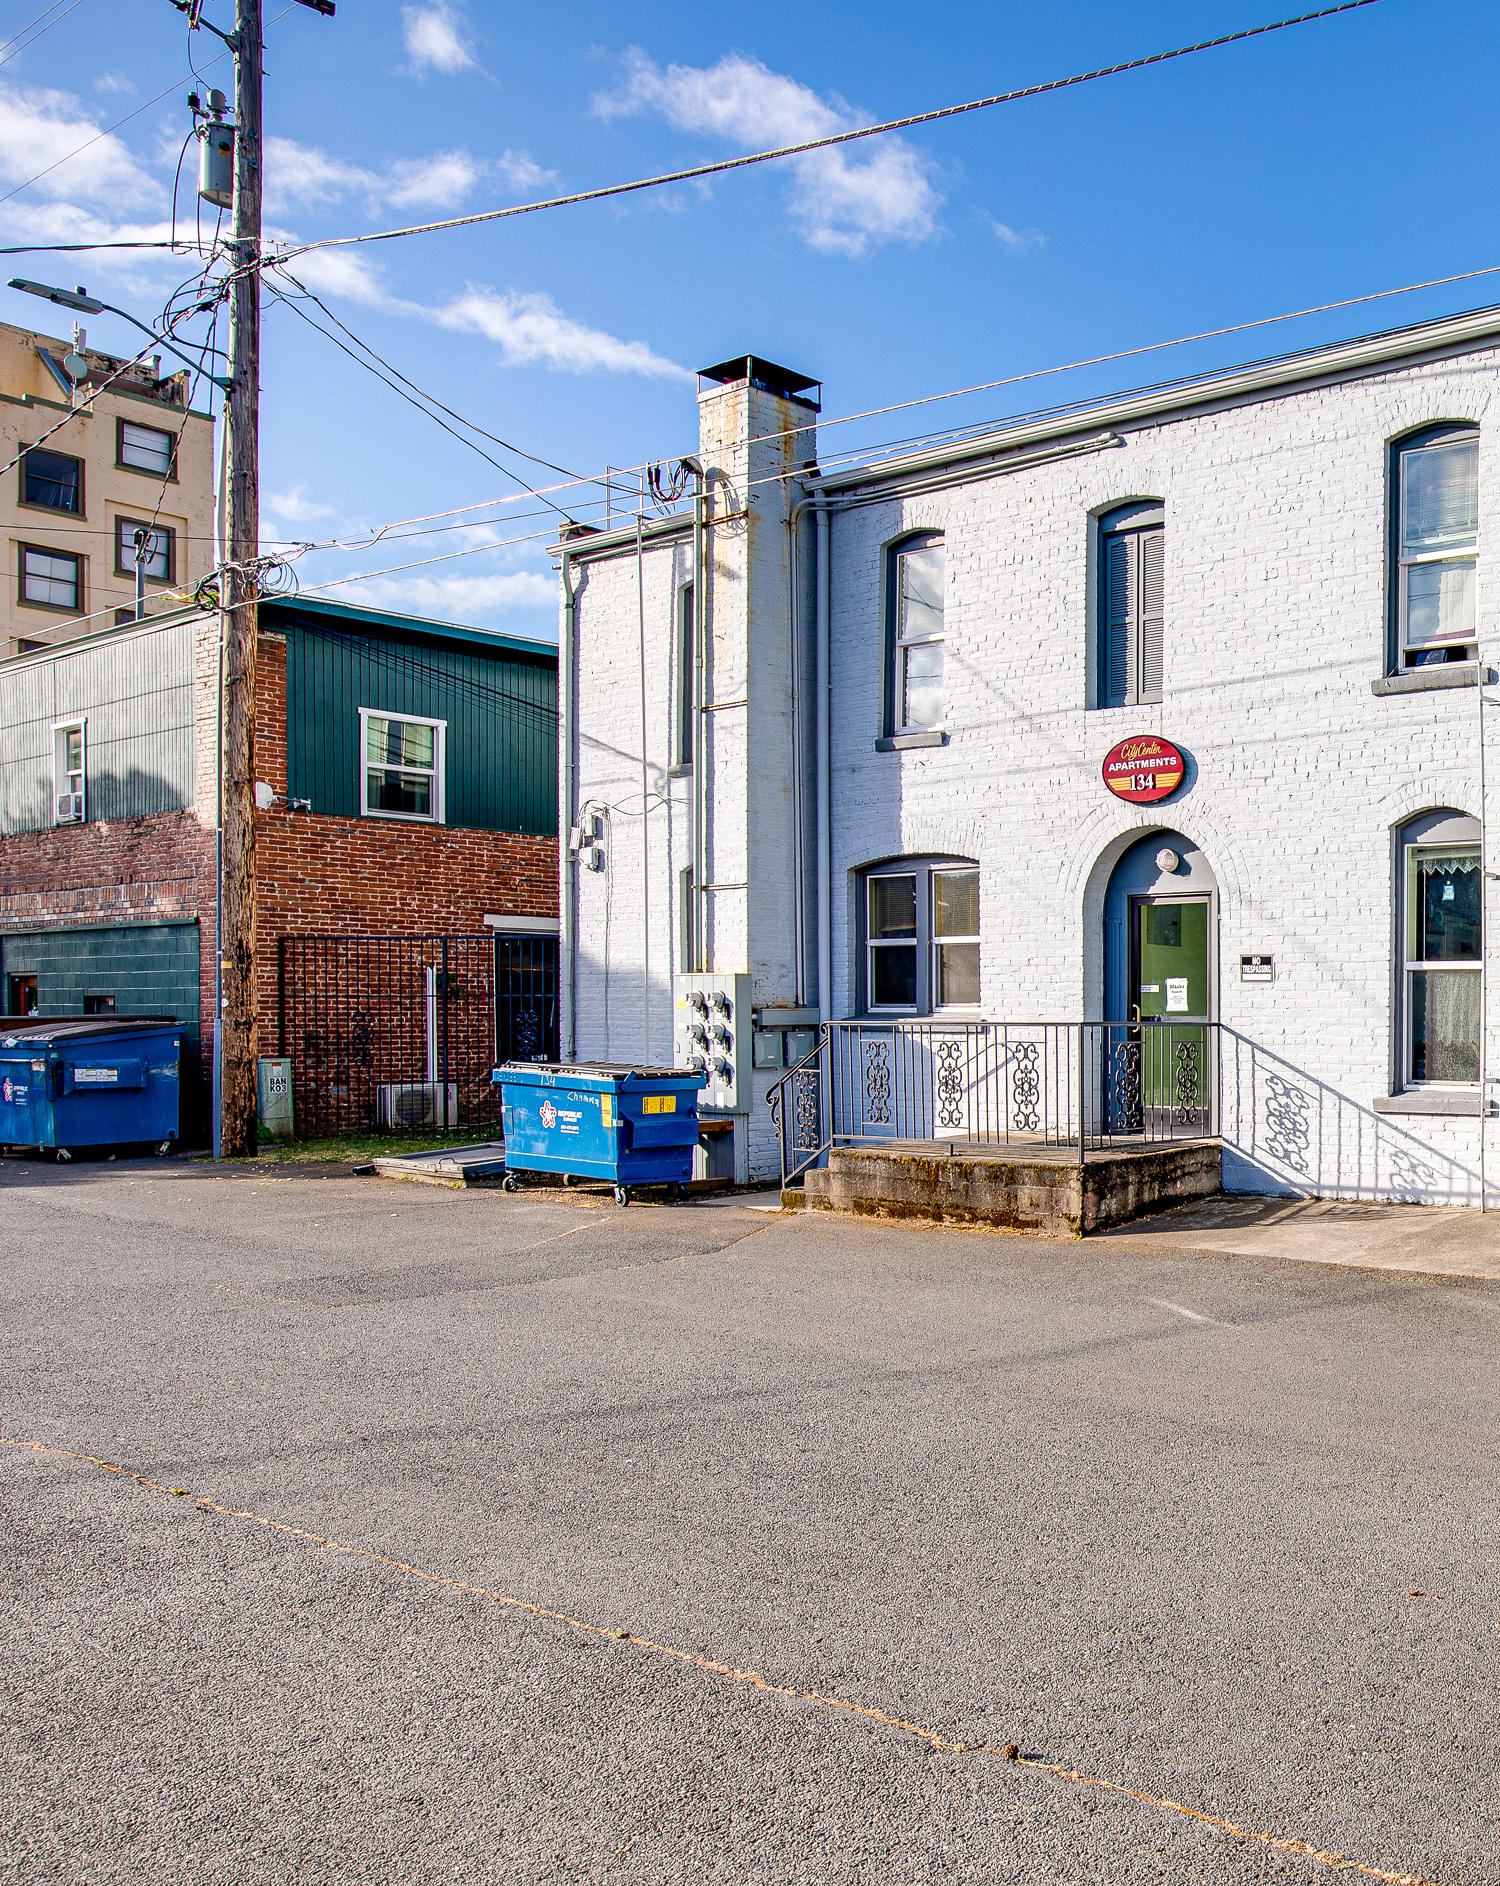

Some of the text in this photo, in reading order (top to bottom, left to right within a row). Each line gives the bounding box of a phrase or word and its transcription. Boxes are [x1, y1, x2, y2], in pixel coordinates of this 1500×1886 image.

[1108, 757, 1177, 772] APARTMENTS
[1129, 773, 1154, 791] 134
[1252, 957, 1260, 965] NO
[1243, 965, 1271, 974] TRESPASSING
[540, 1075, 555, 1087] 134
[557, 1110, 582, 1118] REPUBLIC
